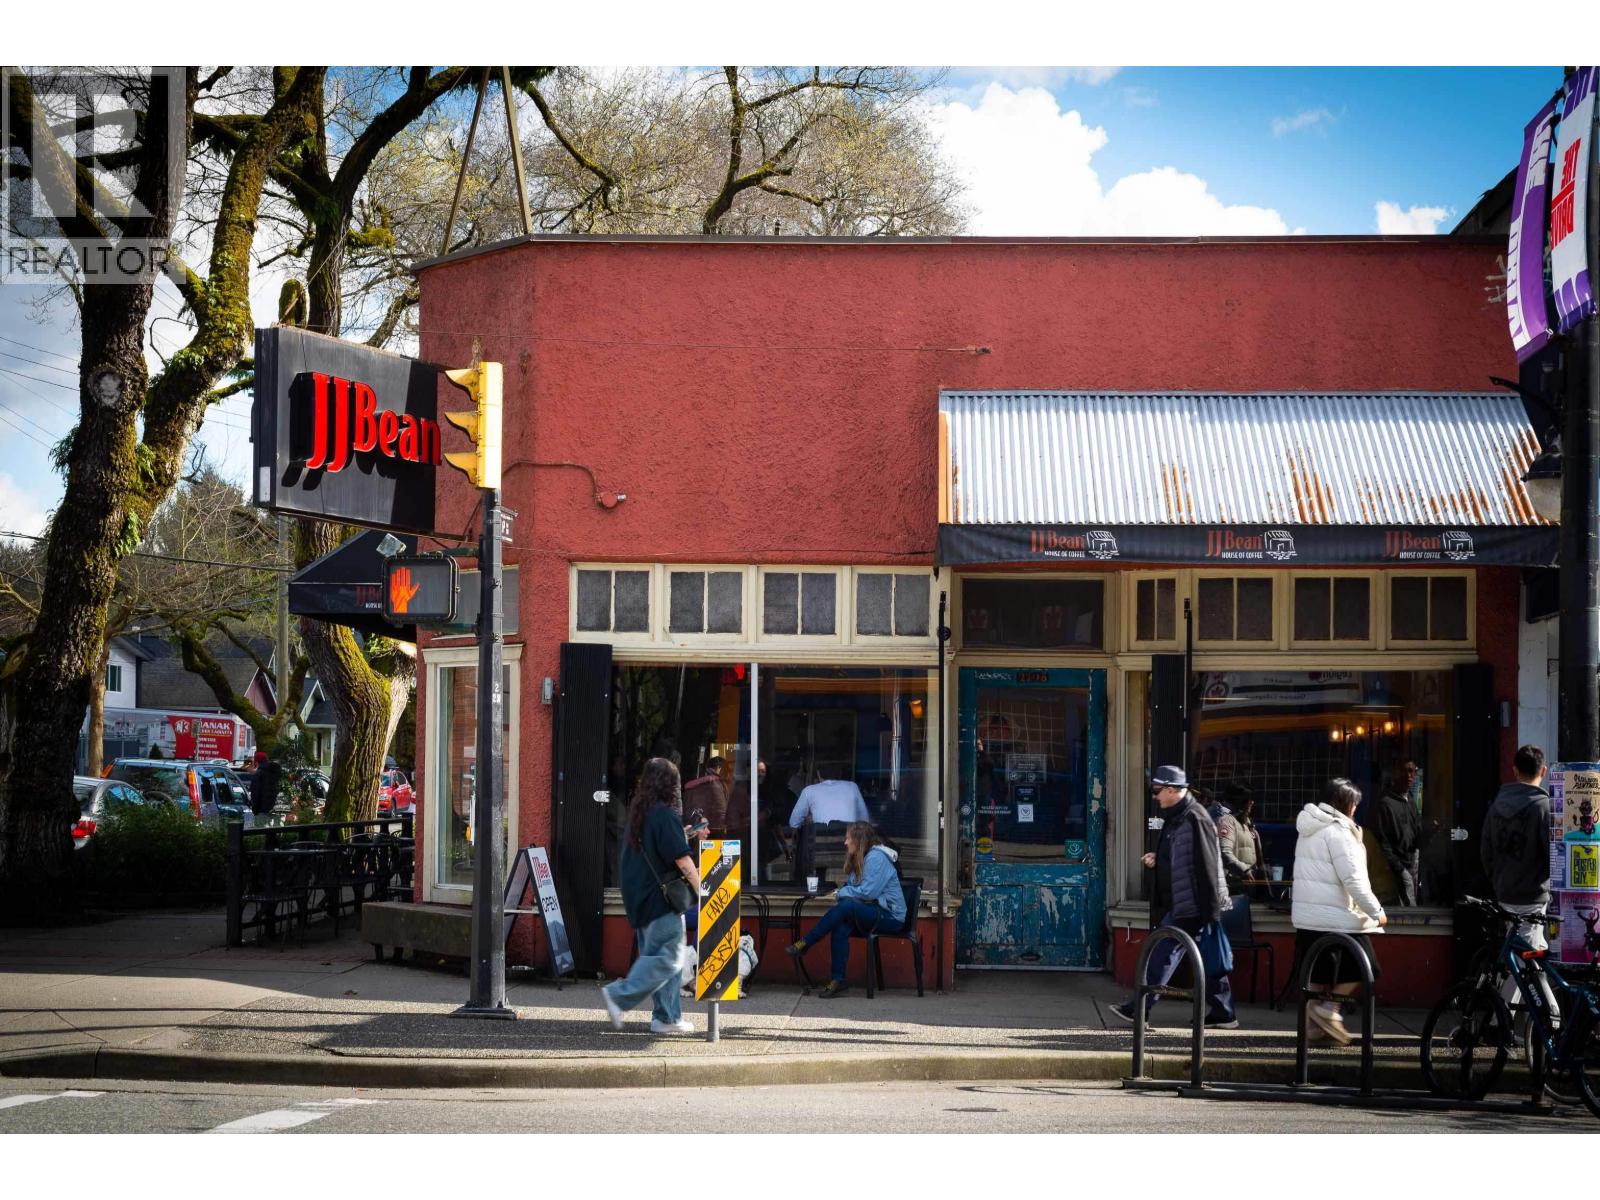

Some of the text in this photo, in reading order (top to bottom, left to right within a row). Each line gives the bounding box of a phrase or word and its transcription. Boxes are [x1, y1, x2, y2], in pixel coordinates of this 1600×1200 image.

[1245, 551, 1263, 559] COFFEE
[1399, 551, 1440, 559] HOUSE OF COFFEE
